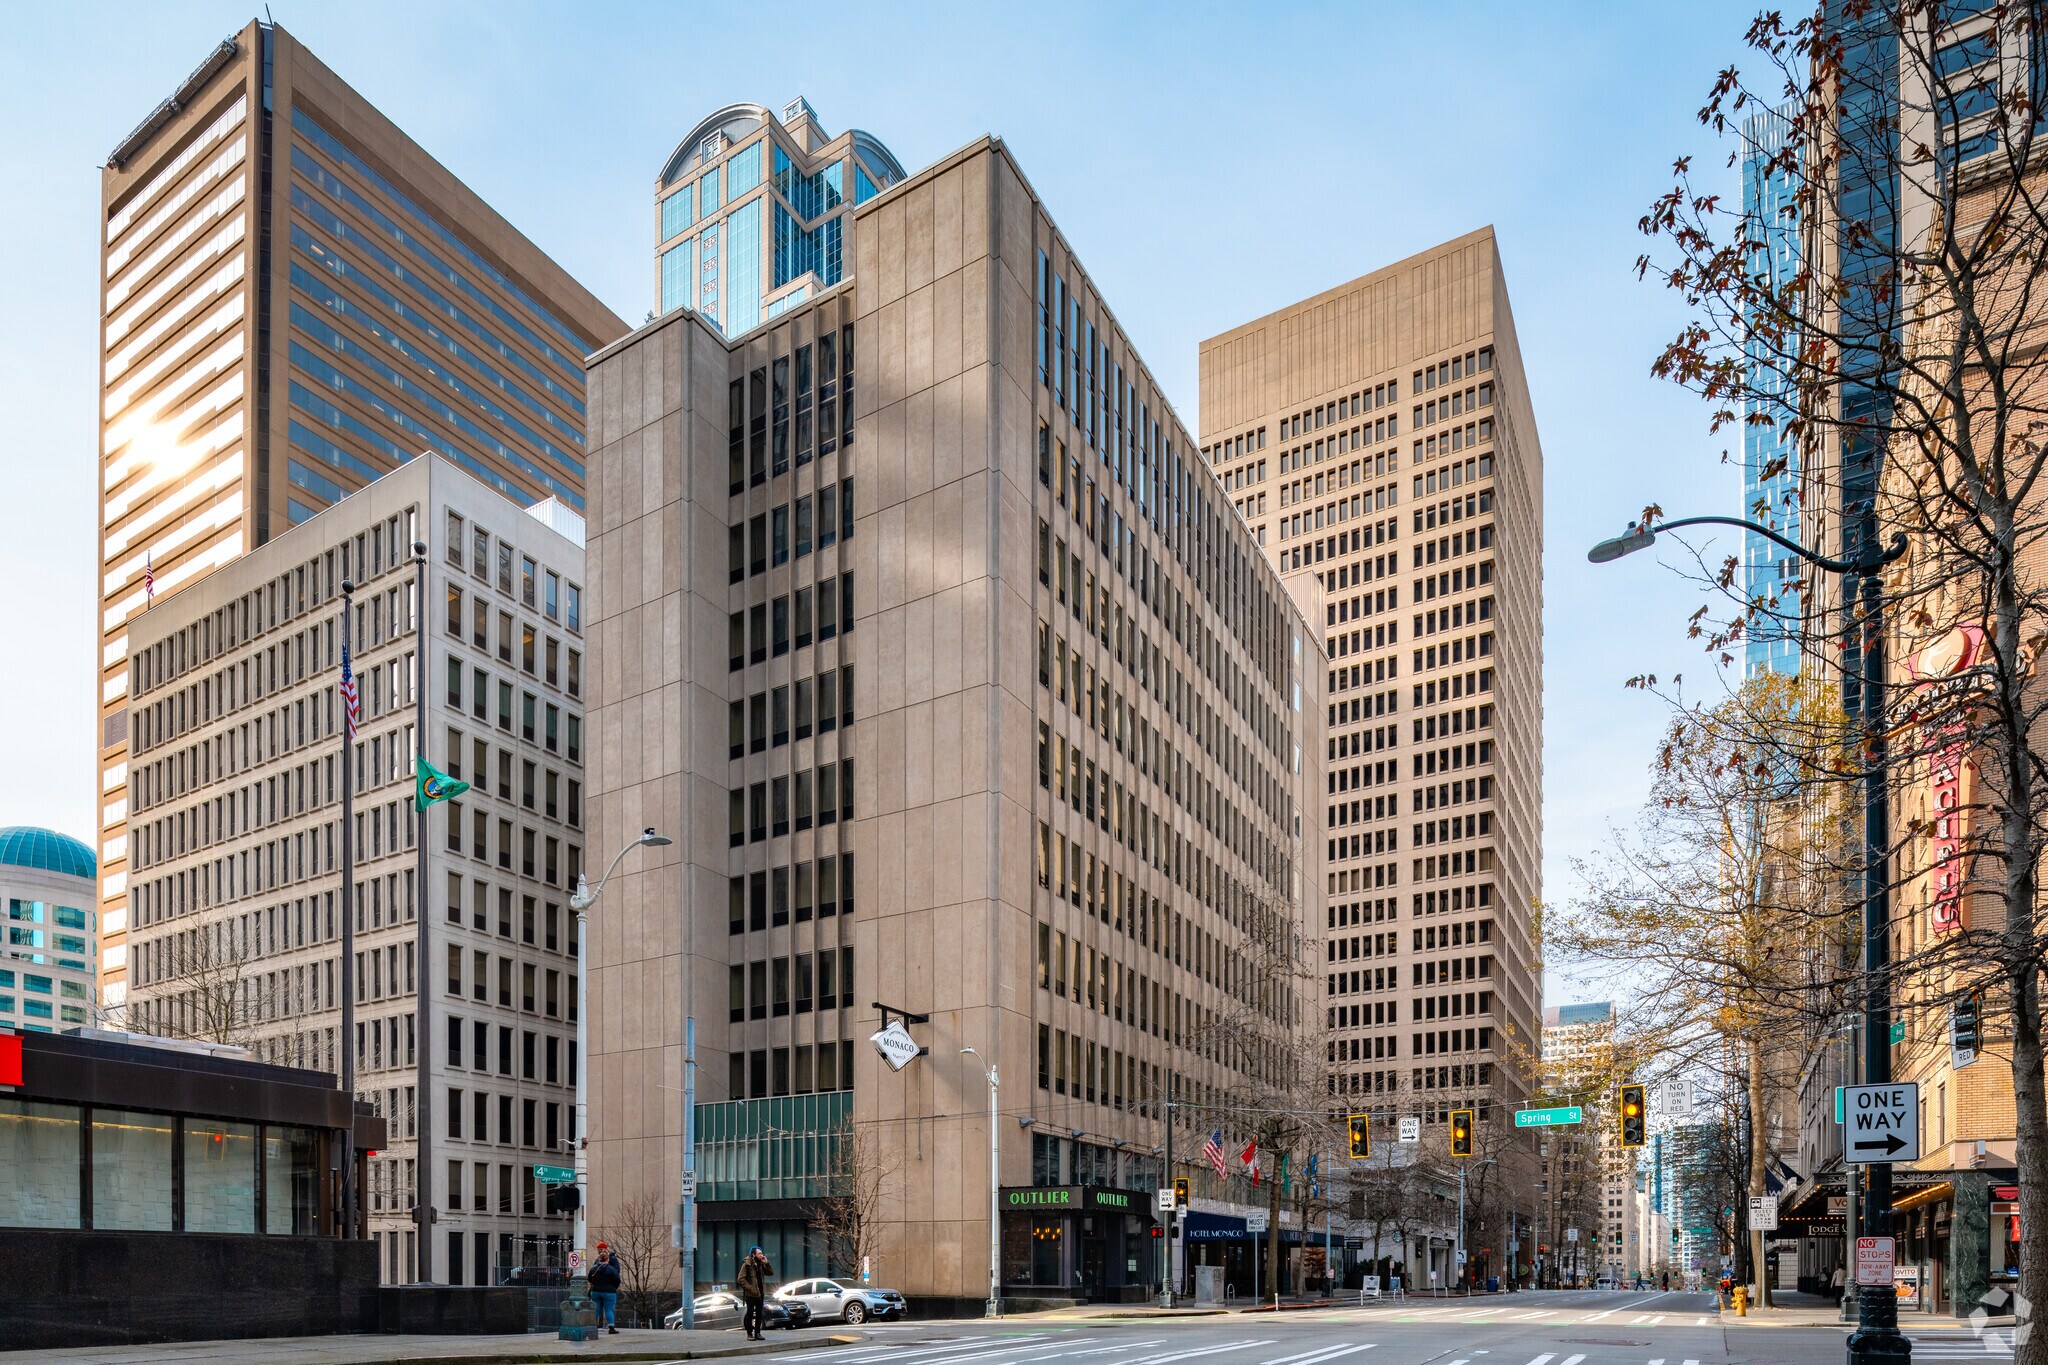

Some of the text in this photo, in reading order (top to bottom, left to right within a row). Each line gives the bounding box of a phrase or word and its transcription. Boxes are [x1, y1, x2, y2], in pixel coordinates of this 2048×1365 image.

[1934, 738, 1958, 924] ACIFIC
[883, 1037, 914, 1053] MONACO
[1958, 1050, 1971, 1062] RED
[1669, 1083, 1684, 1091] NO
[1857, 1090, 1905, 1109] ONE
[1521, 1113, 1551, 1124] Spring
[1856, 1111, 1907, 1131] WAY
[683, 1171, 694, 1179] ONE
[1009, 1191, 1069, 1205] OUTLIER
[1096, 1192, 1128, 1207] OUTLIER
[1190, 1230, 1244, 1238] HOTEL MONACO
[1807, 1225, 1840, 1236] LODGE
[1860, 1239, 1874, 1247] NO
[1860, 1250, 1891, 1259] STOPS
